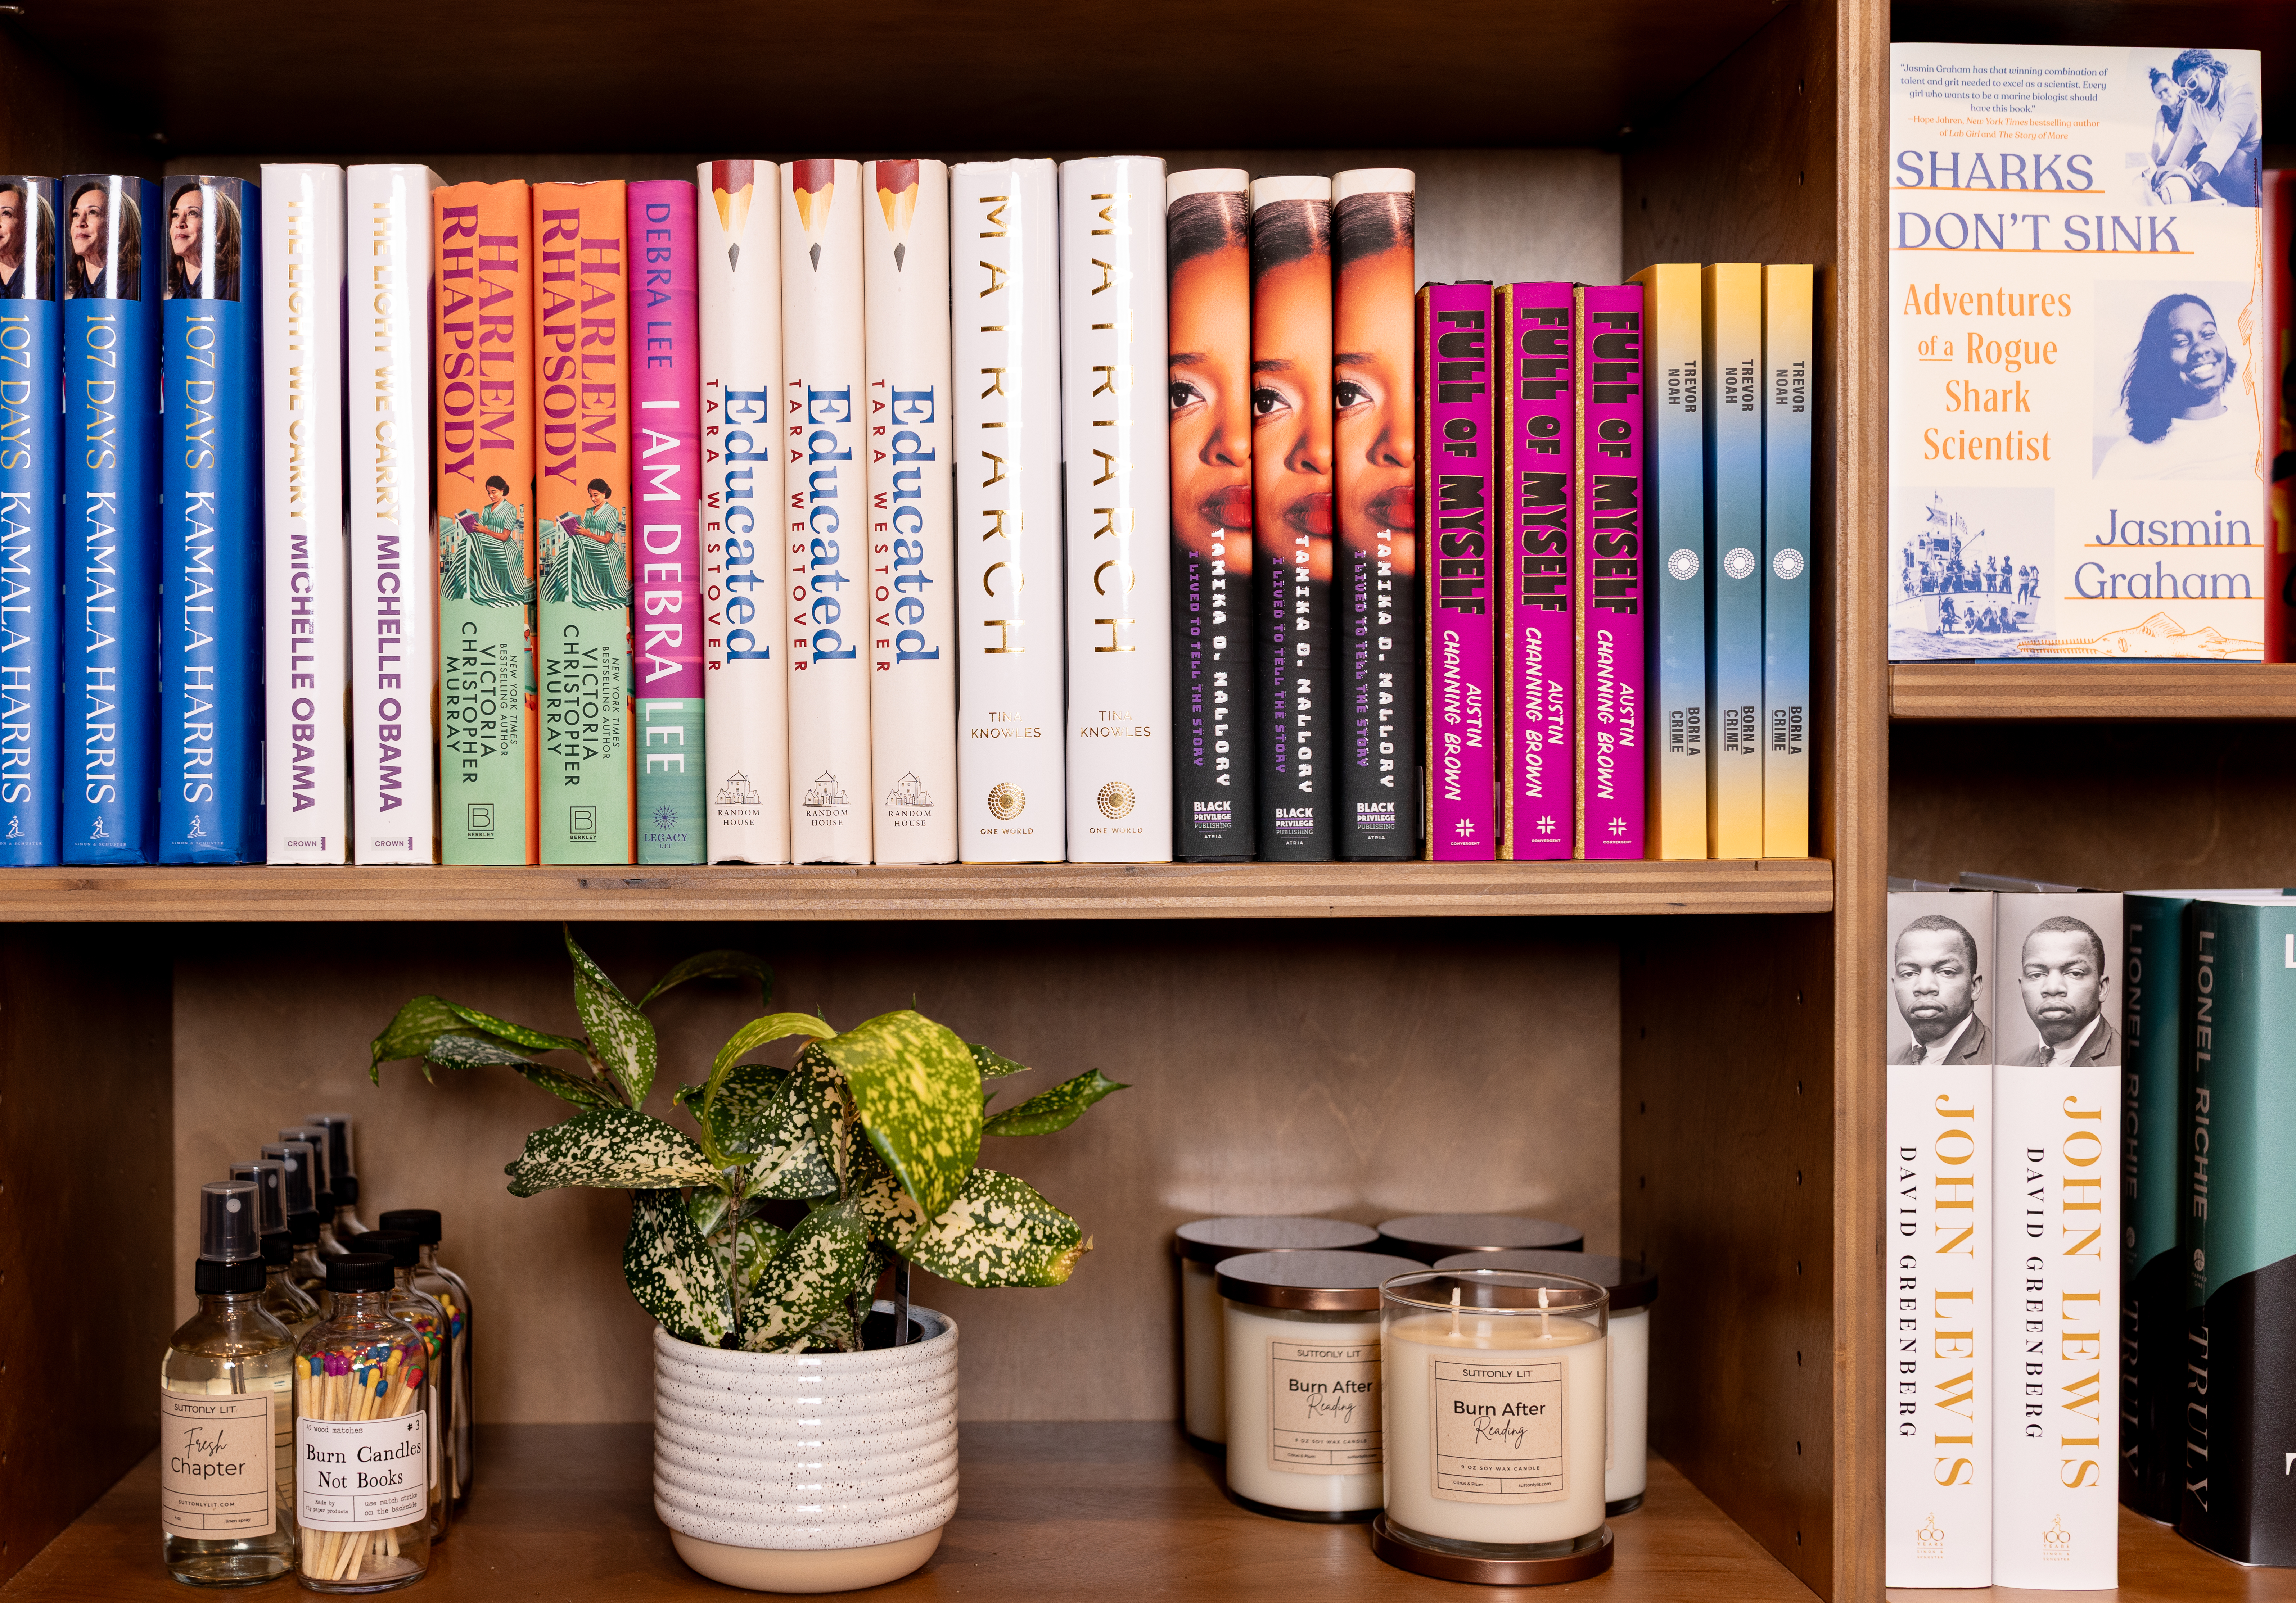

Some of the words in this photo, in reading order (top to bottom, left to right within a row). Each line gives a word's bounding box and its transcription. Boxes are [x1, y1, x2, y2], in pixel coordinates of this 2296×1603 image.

[1945, 78, 1959, 87] grit
[2083, 81, 2106, 90] Every
[2009, 67, 2042, 76] winning
[1910, 90, 1923, 98] girl
[2033, 93, 2068, 102] biologist
[2030, 119, 2071, 127] bestselling
[1896, 150, 2093, 191] SHARKS
[646, 203, 671, 308] DEBRA
[2064, 215, 2180, 253] SINK
[1904, 284, 2071, 317] Adventures
[87, 314, 116, 368] 107
[443, 204, 478, 484] RHAPSODY
[479, 234, 518, 451] HARLEM
[647, 322, 672, 369] LEE
[1593, 311, 1639, 403] FULL
[1918, 335, 1938, 356] of
[1944, 340, 1954, 356] a
[1967, 332, 2058, 373] Rogue
[1776, 369, 1788, 405] NOAH
[1793, 361, 1804, 413] TREVOR
[1946, 380, 2030, 412] Shark
[87, 380, 116, 469] DAYS
[706, 379, 719, 463] TARA
[1091, 193, 1136, 652] MATRIARCH
[1598, 418, 1632, 458] OF
[1924, 428, 2051, 461] Scientist
[642, 428, 681, 501] AM
[725, 385, 770, 664] Educated
[1593, 475, 1638, 615] MYSELF
[2096, 509, 2252, 546] Jasmin
[86, 491, 116, 653] KAMALA
[707, 492, 721, 671] WESTOVER
[1273, 557, 1284, 565] I
[1295, 535, 1311, 631] TAMIKA
[2075, 561, 2252, 599] Graham
[377, 534, 401, 690] MICHELLE
[643, 524, 683, 683] DEBRA
[1273, 570, 1284, 619] LIVED
[1274, 624, 1284, 642] TO
[1296, 643, 1311, 667] D.
[1275, 647, 1285, 685] TELL
[1597, 630, 1614, 724] CHANNING
[446, 656, 460, 752] MURRAY
[462, 621, 478, 783] CHRISTOPHER
[479, 645, 496, 757] VICTORIA
[1099, 710, 1133, 721] TINA
[1275, 691, 1285, 719] THE
[1619, 682, 1634, 747] AUSTIN
[1790, 706, 1802, 742] BORN
[86, 666, 116, 804] HARRIS
[646, 702, 684, 774] LEE
[1081, 726, 1151, 737] KNOWLES
[1275, 725, 1286, 773] STORY
[1296, 679, 1312, 793] MALLORY
[1774, 710, 1786, 751] CRIME
[379, 698, 402, 813] OBAMA
[1597, 732, 1614, 800] BROWN
[1276, 808, 1313, 818] BLACK
[645, 833, 688, 842] LEGACY
[2196, 930, 2214, 1072] LIONEL
[2193, 1087, 2210, 1219] RICHIE
[2027, 1147, 2044, 1237] DAVID
[2063, 1096, 2102, 1261] JOHN
[2025, 1256, 2044, 1439] GREENBERG
[175, 1404, 215, 1413] SUTTONLY
[1454, 1400, 1496, 1416] Burn
[1502, 1402, 1546, 1416] After
[2061, 1289, 2100, 1489] LEWIS
[184, 1427, 227, 1458] Fresh
[1474, 1416, 1528, 1449] Reading
[2187, 1326, 2208, 1512] TRULY
[171, 1457, 245, 1480] Chapter
[306, 1444, 346, 1463] Burn
[357, 1441, 421, 1462] Candles
[318, 1471, 347, 1488] Not
[357, 1469, 403, 1488] Books
[380, 1496, 398, 1505] match
[401, 1493, 417, 1502] strike
[392, 1502, 417, 1512] backside
[2042, 1531, 2070, 1543] 100
